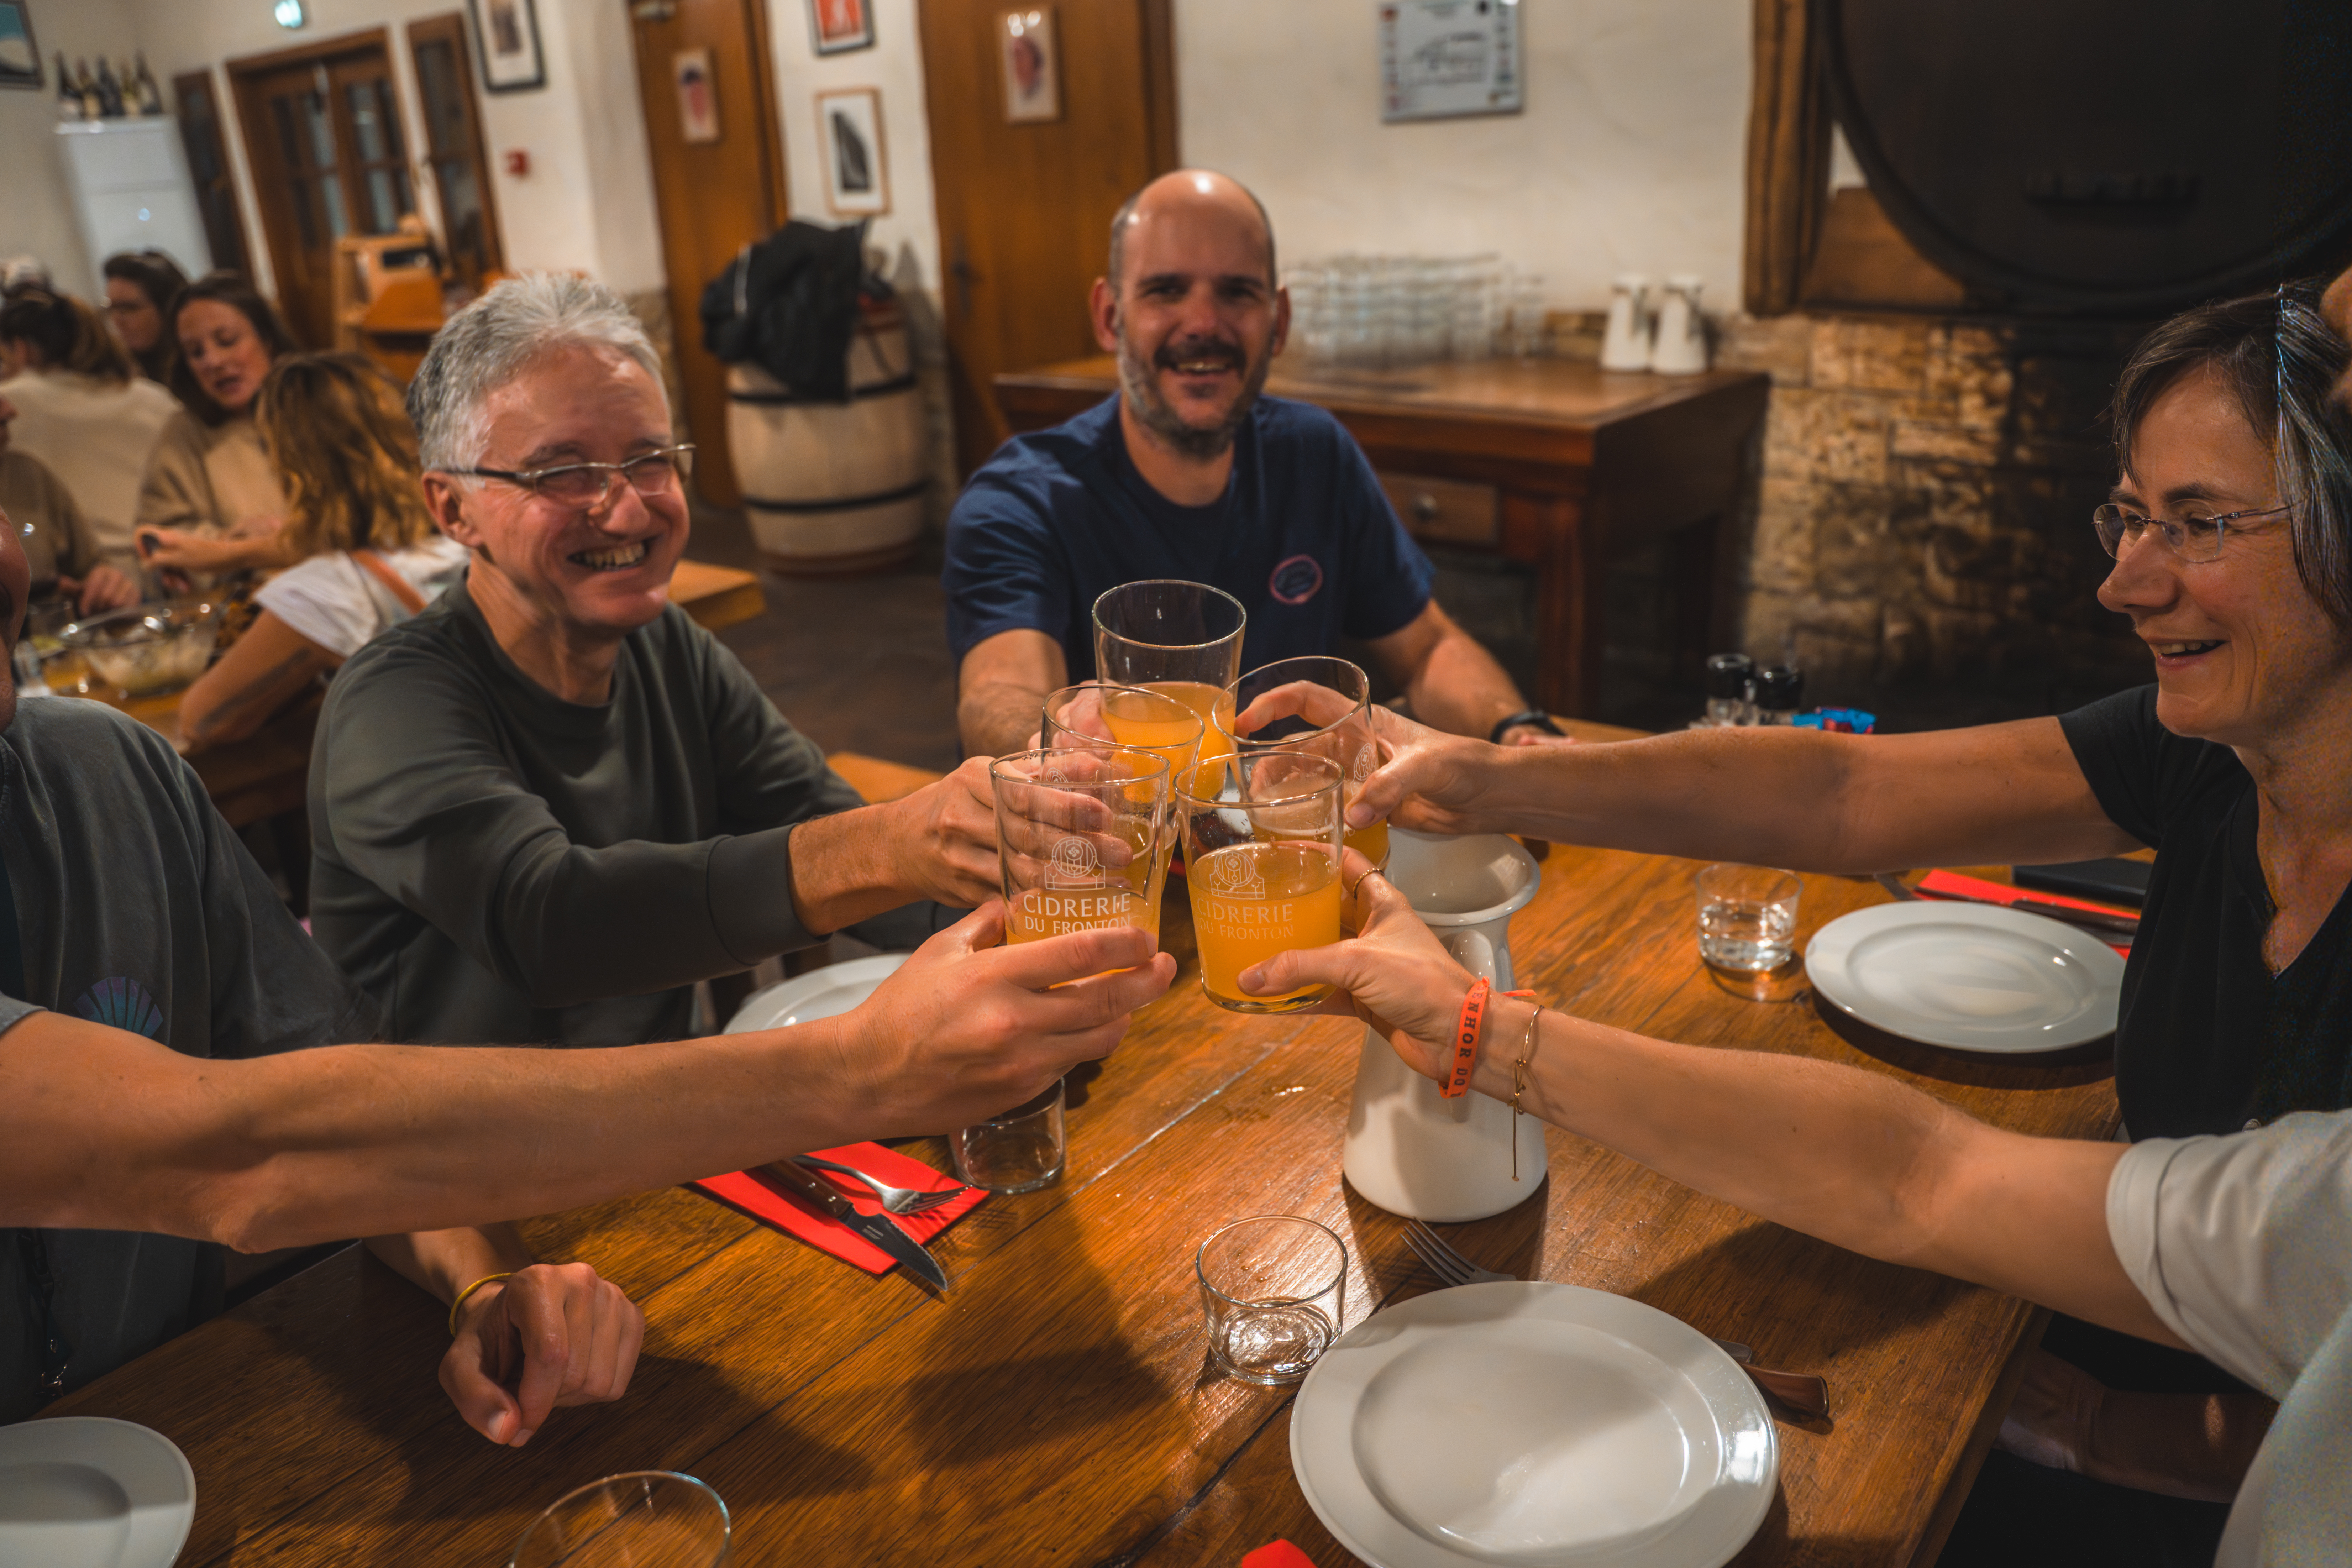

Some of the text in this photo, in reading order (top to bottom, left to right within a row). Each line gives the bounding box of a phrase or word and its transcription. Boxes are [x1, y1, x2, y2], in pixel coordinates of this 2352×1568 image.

[1023, 893, 1131, 917] CIDRERIE
[1197, 898, 1293, 924] CIDRERIE
[1025, 913, 1131, 934] DU FRONTON
[1199, 917, 1293, 940] DU FRONTON
[1454, 1068, 1468, 1086] DO
